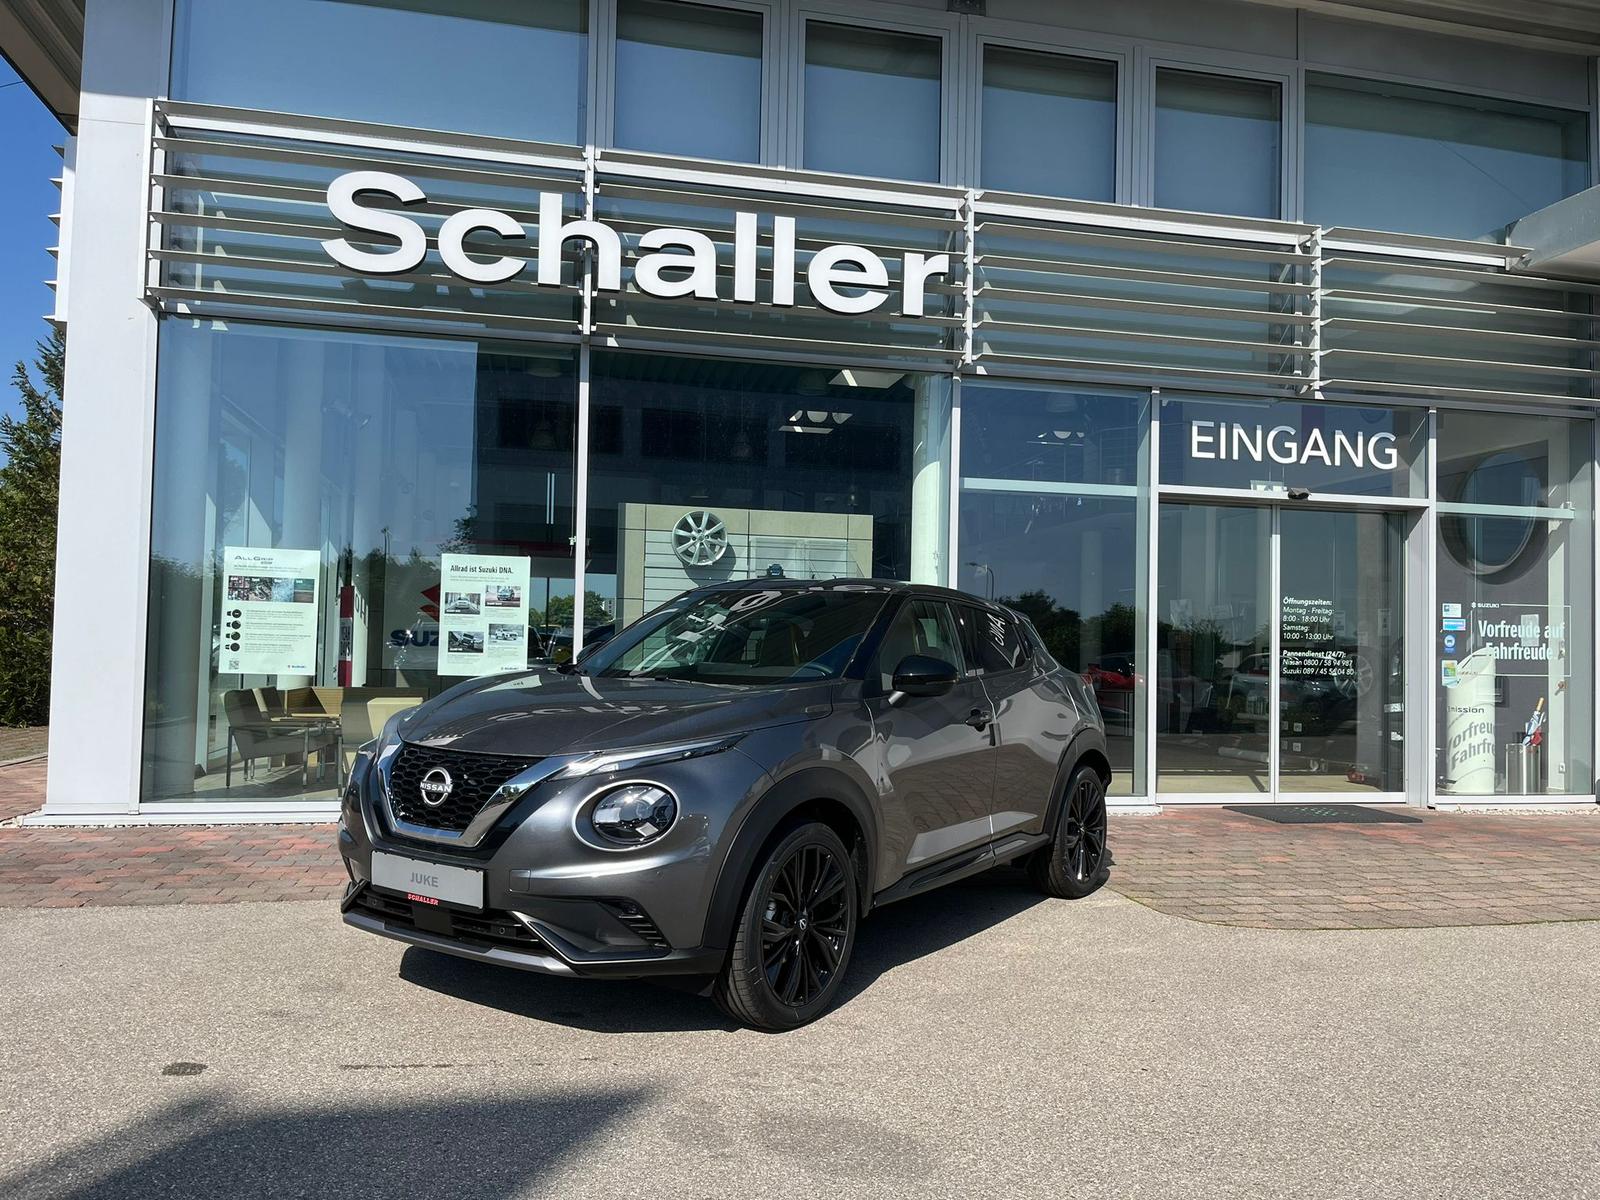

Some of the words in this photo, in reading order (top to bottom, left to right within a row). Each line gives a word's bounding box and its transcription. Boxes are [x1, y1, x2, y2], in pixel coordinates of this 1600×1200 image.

[320, 170, 949, 317] Schaller
[1191, 420, 1398, 470] EINGANG
[478, 566, 498, 574] Suzuki
[1283, 596, 1332, 606] Öffnungszeiten:
[1283, 606, 1306, 615] Montag
[1311, 607, 1334, 616] Freitag:
[1283, 623, 1310, 632] Samstag:
[1478, 620, 1540, 638] Vorfreude
[1544, 621, 1565, 639] auf
[1283, 649, 1325, 657] Pannendienst
[420, 781, 453, 793] NISSAN
[410, 871, 439, 888] JUKE
[407, 893, 439, 906] SCHALLER
